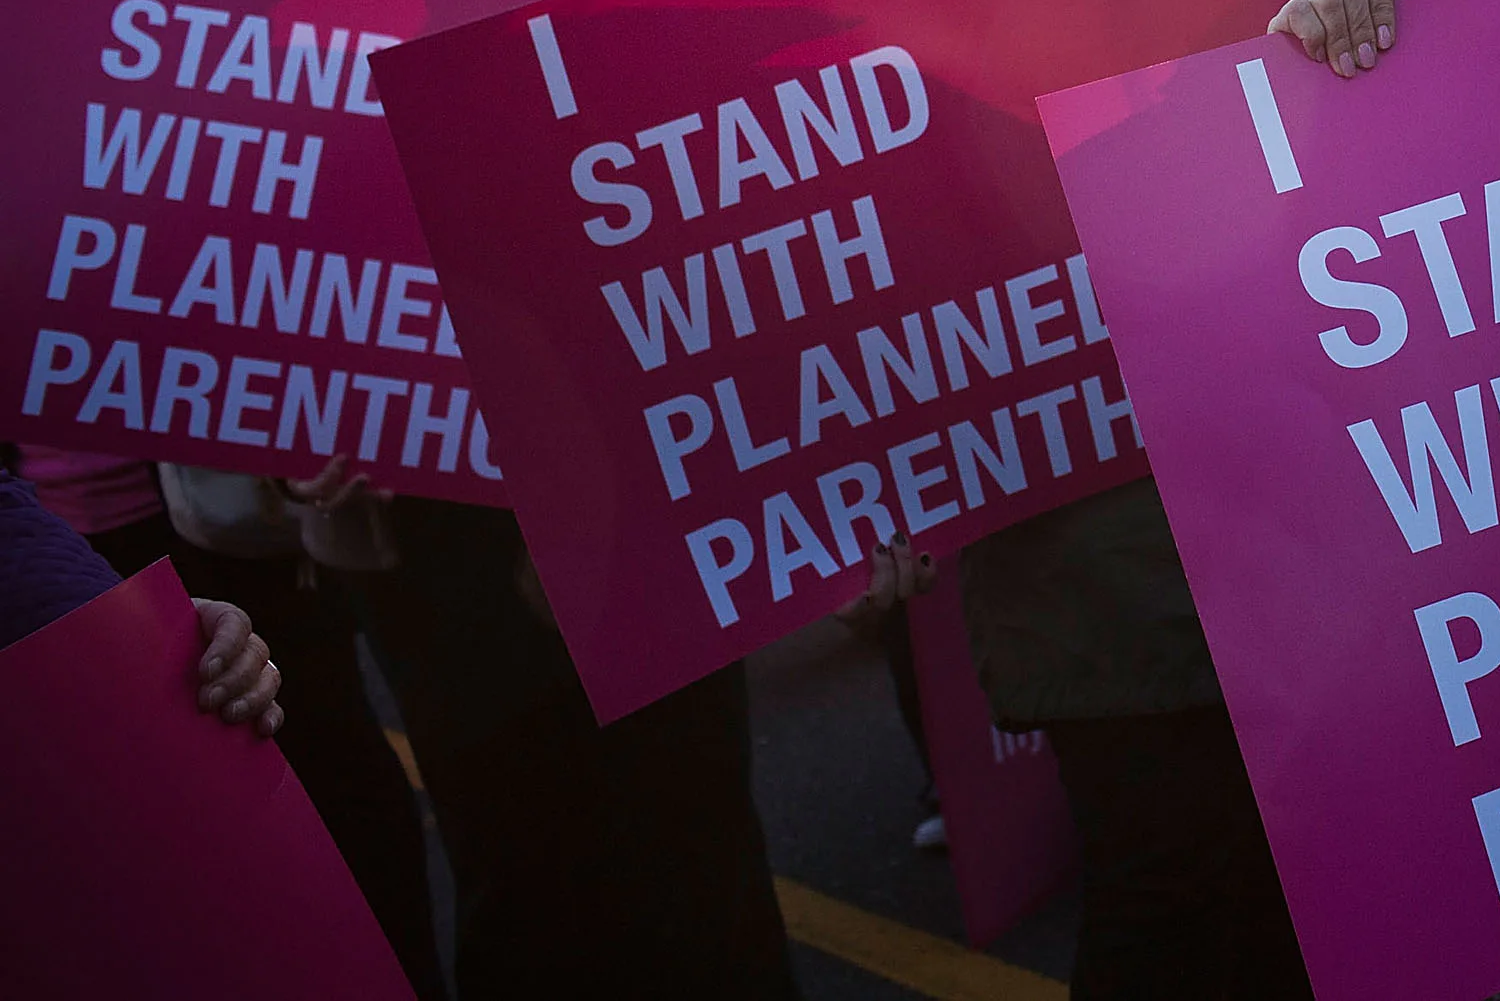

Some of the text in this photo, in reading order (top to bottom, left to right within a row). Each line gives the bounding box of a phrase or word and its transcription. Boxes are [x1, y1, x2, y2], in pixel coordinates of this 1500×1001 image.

[527, 14, 578, 120] I
[1235, 57, 1303, 195] I
[83, 103, 324, 220] WITH
[570, 46, 930, 247] STAND
[600, 195, 896, 372] WITH
[21, 330, 503, 480] PARENTH
[684, 375, 1145, 629] PARENTH
